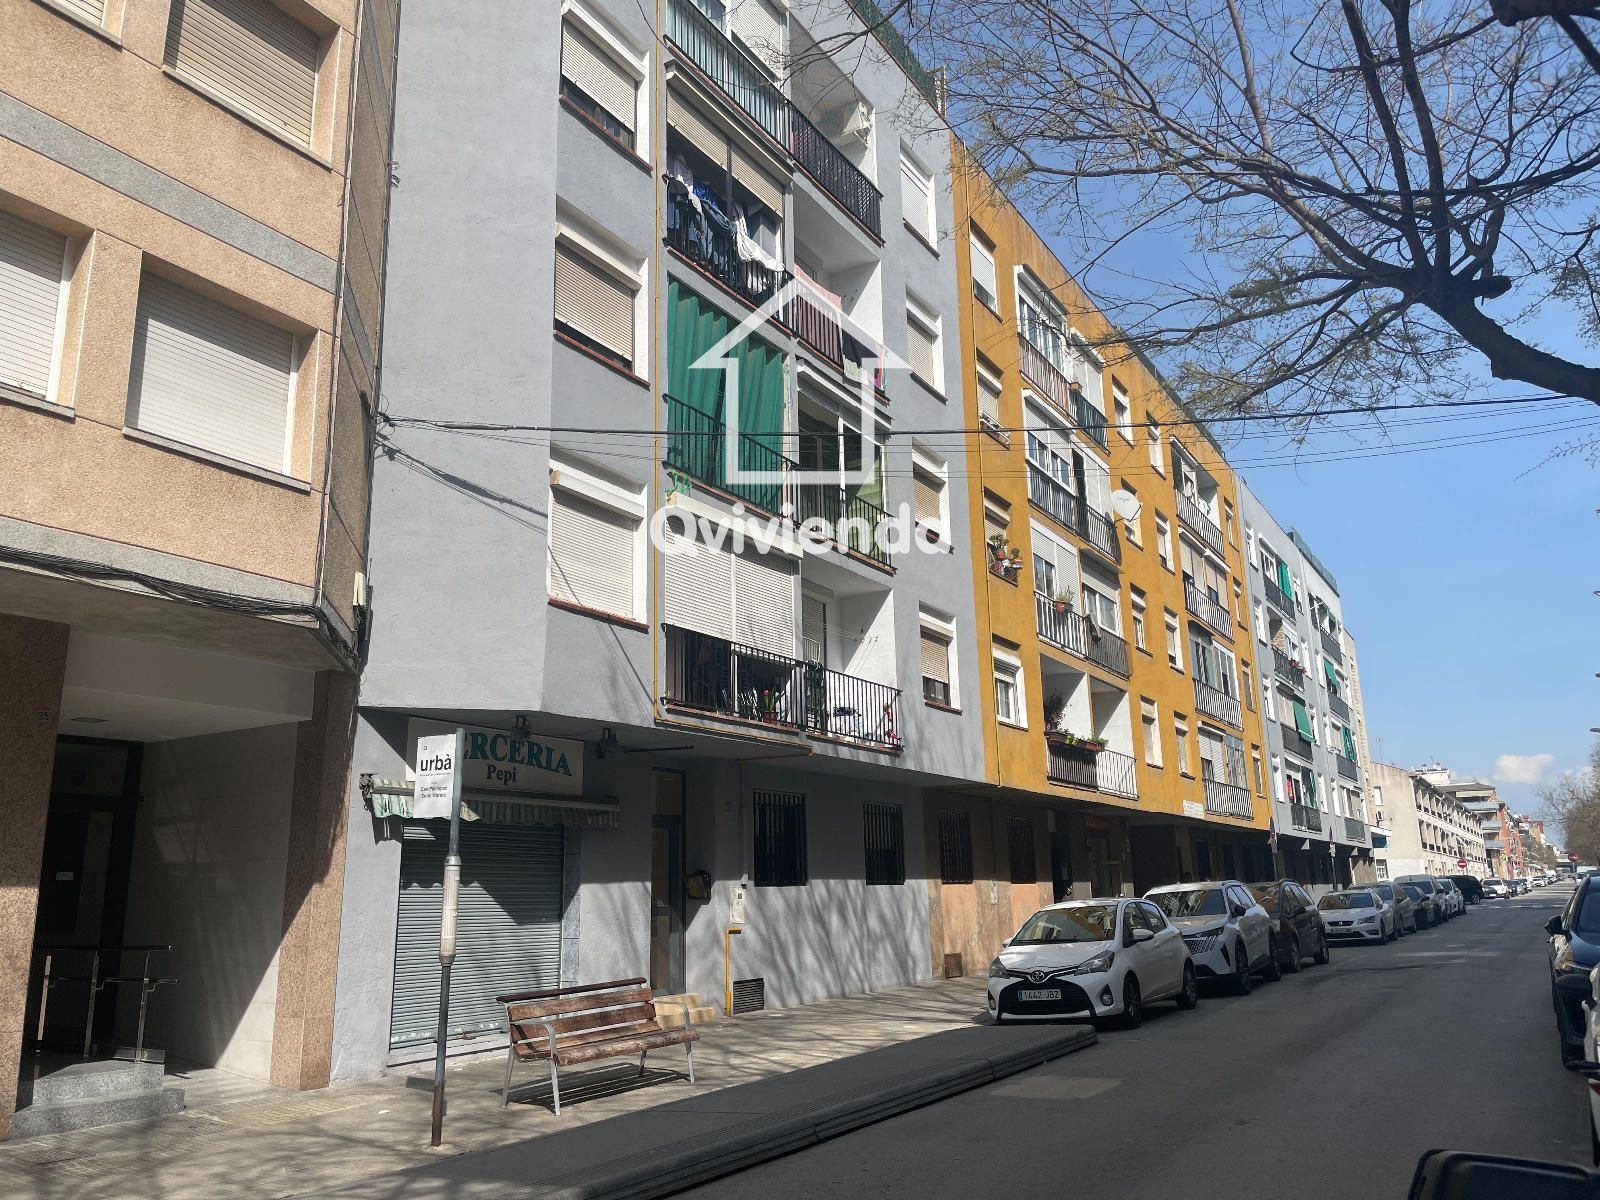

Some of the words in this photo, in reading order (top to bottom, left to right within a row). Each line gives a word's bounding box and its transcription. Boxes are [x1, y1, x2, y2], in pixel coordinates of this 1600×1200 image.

[420, 753, 452, 772] urbà
[463, 732, 573, 777] RCERIA
[486, 763, 518, 786] Pepi
